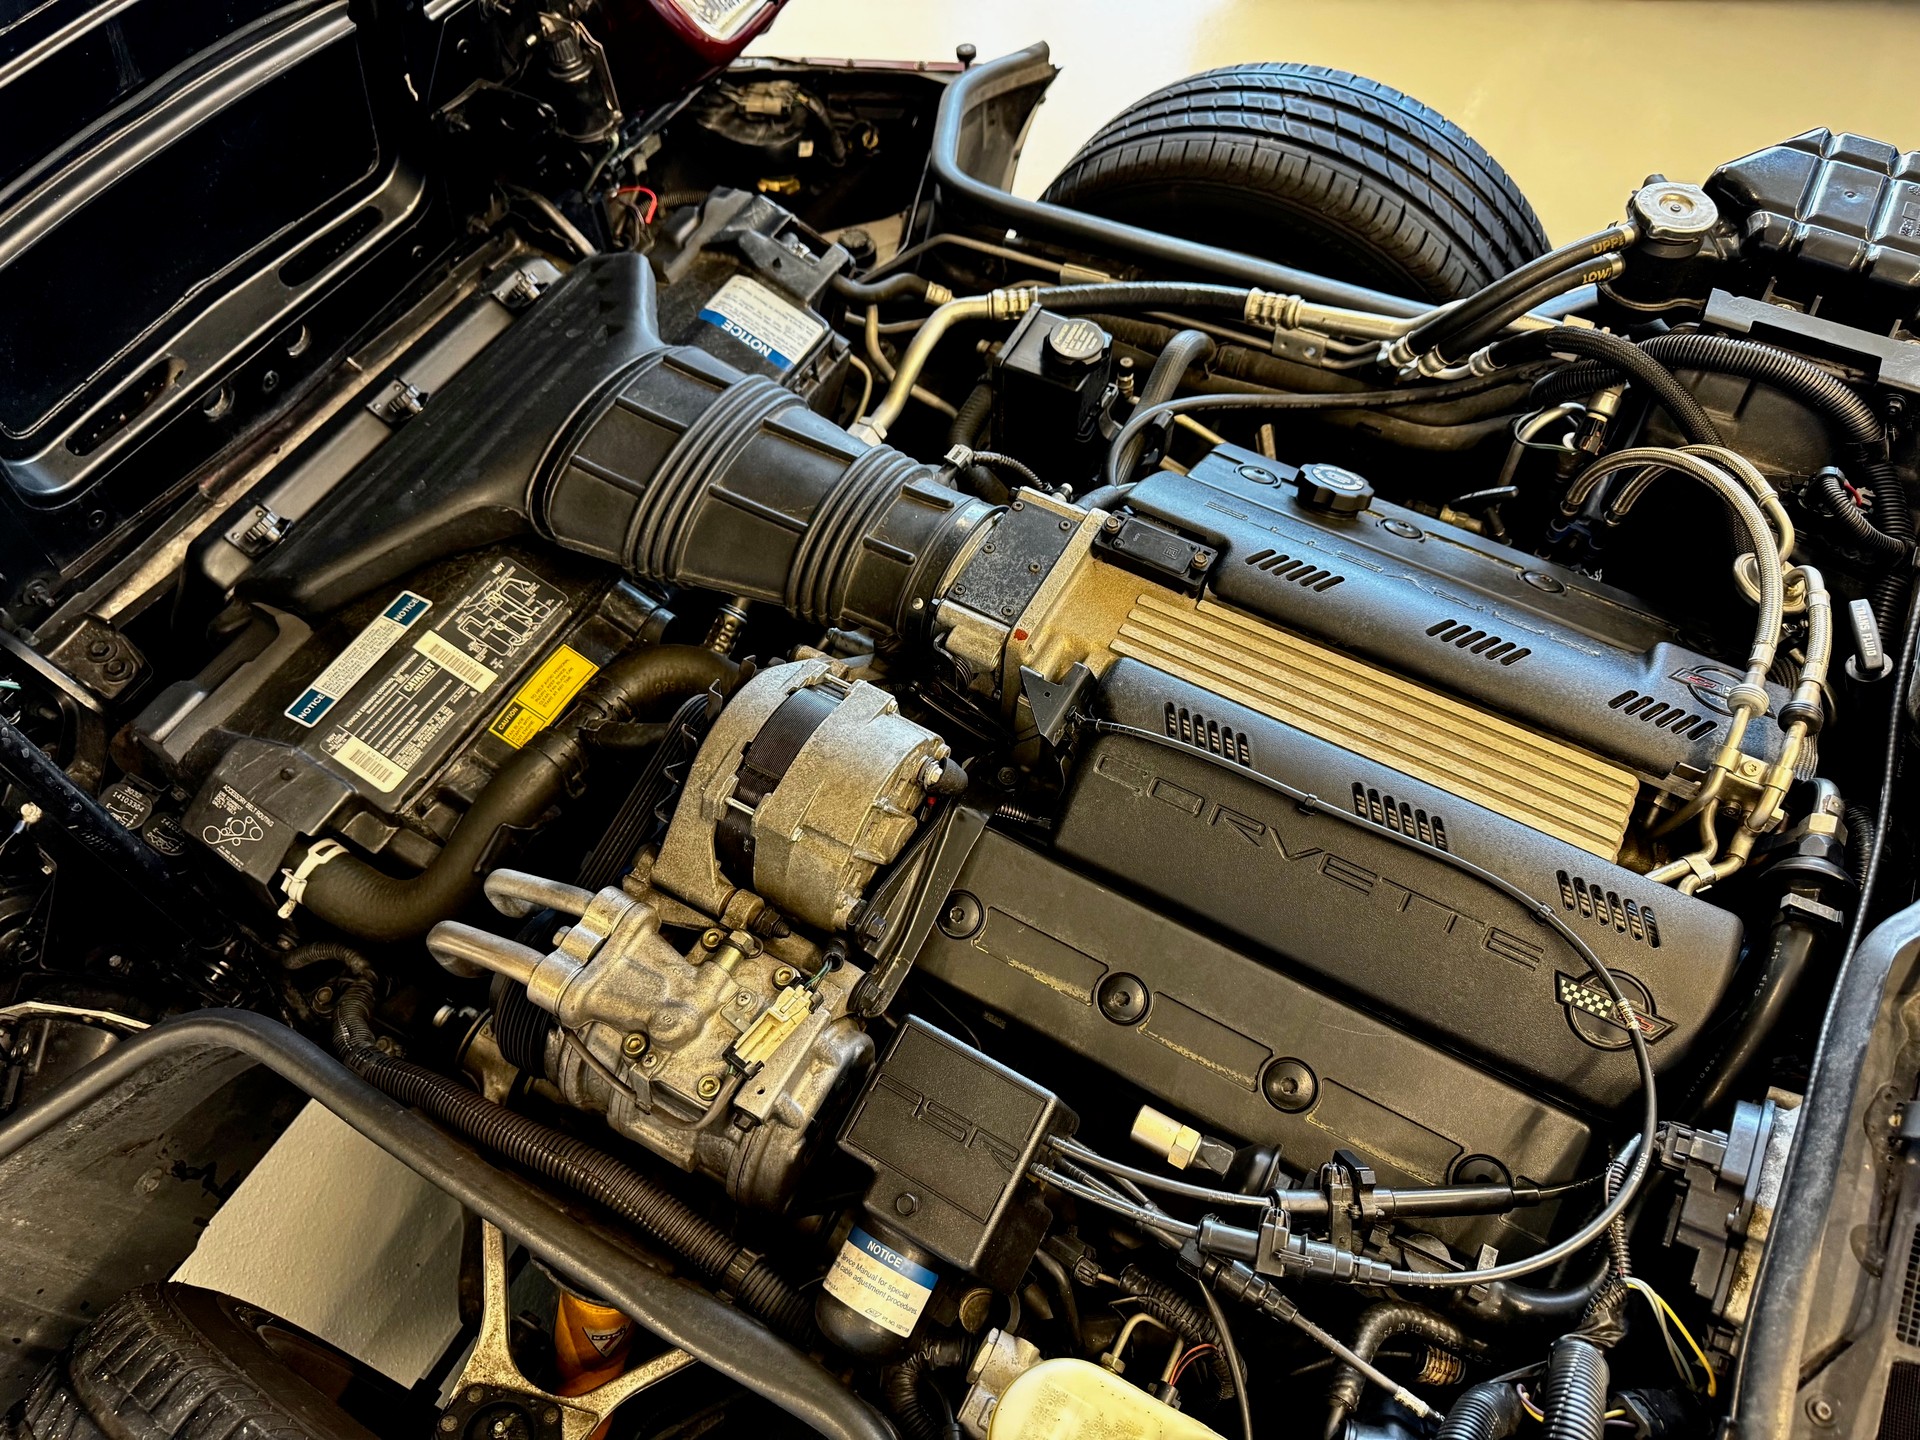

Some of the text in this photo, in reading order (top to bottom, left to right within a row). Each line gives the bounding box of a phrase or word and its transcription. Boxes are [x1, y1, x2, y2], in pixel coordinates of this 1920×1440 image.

[1591, 235, 1625, 254] UPPE
[720, 319, 772, 357] NOTICE
[392, 597, 420, 621] NOTICE
[1855, 606, 1876, 656] TRANS FLUID
[403, 661, 435, 692] CATALYST
[535, 684, 545, 694] HELP
[543, 673, 555, 685] AVOID
[552, 657, 570, 674] PERSONAL
[546, 678, 556, 689] KEEP
[554, 667, 566, 679] HANDS
[549, 684, 557, 692] FAN
[555, 673, 567, 685] BLADE
[565, 666, 574, 674] CAN
[344, 652, 419, 728] VEHICLE EMISSION CONTROL INFORMATION
[541, 695, 553, 707] START
[556, 683, 565, 691] ANY
[297, 693, 326, 719] NOTICE
[497, 706, 519, 730] CAUTION
[506, 717, 525, 737] FAN BLADE
[510, 715, 532, 740] STARTS WITH
[514, 720, 535, 742] OUT ENGINE
[112, 791, 144, 812] 14103304
[124, 786, 142, 799] 3032
[211, 799, 222, 809] ONLY
[216, 794, 236, 811] DUAL SIDED
[225, 796, 243, 810] CORRECT
[222, 784, 274, 827] ACCESSORY BELT ROUTING
[226, 806, 236, 815] BELT
[1092, 748, 1543, 974] CORVETTE
[868, 1068, 1024, 1173] ASR
[866, 1240, 902, 1268] NOTICE
[839, 1264, 853, 1278] cable
[851, 1273, 887, 1299] adjustment
[840, 1252, 856, 1267] Service
[855, 1262, 878, 1282] Manual
[877, 1277, 887, 1288] for
[886, 1283, 910, 1301] special
